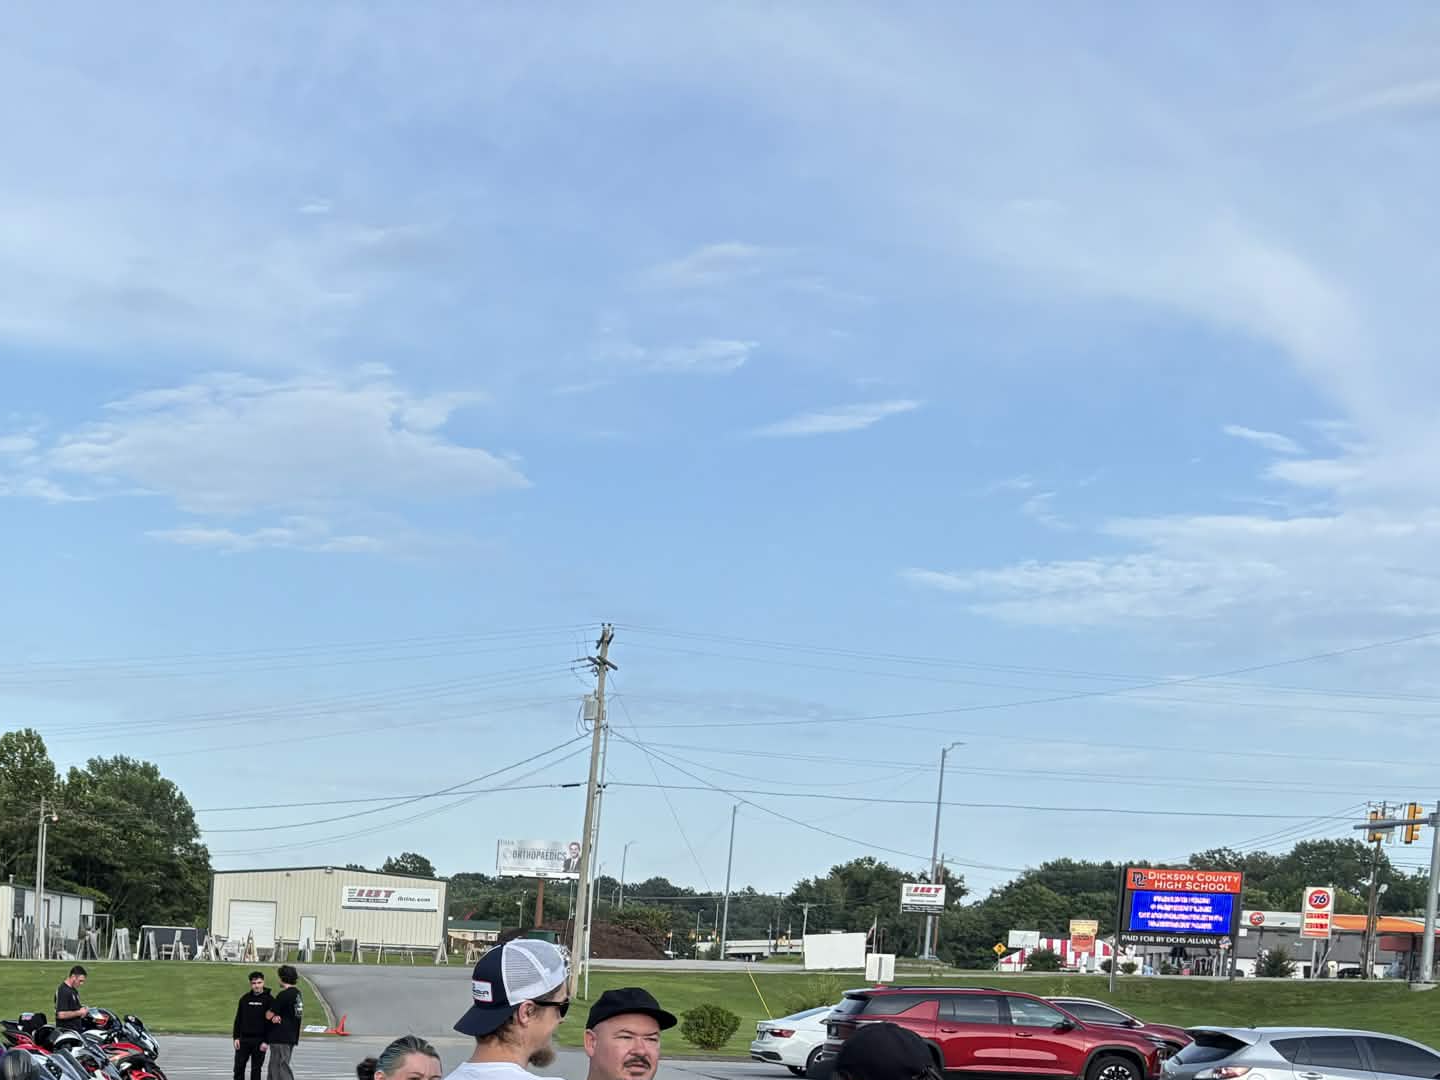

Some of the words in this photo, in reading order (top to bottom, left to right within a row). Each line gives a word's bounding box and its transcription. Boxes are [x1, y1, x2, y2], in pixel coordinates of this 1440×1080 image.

[1148, 871, 1194, 881] DICKSON
[1197, 872, 1240, 882] COUNTY
[1154, 881, 1182, 889] HIGH
[1185, 881, 1231, 891] SCHOOL
[1313, 895, 1326, 904] 76
[1121, 934, 1139, 942] PAID
[1140, 934, 1155, 943] FOR
